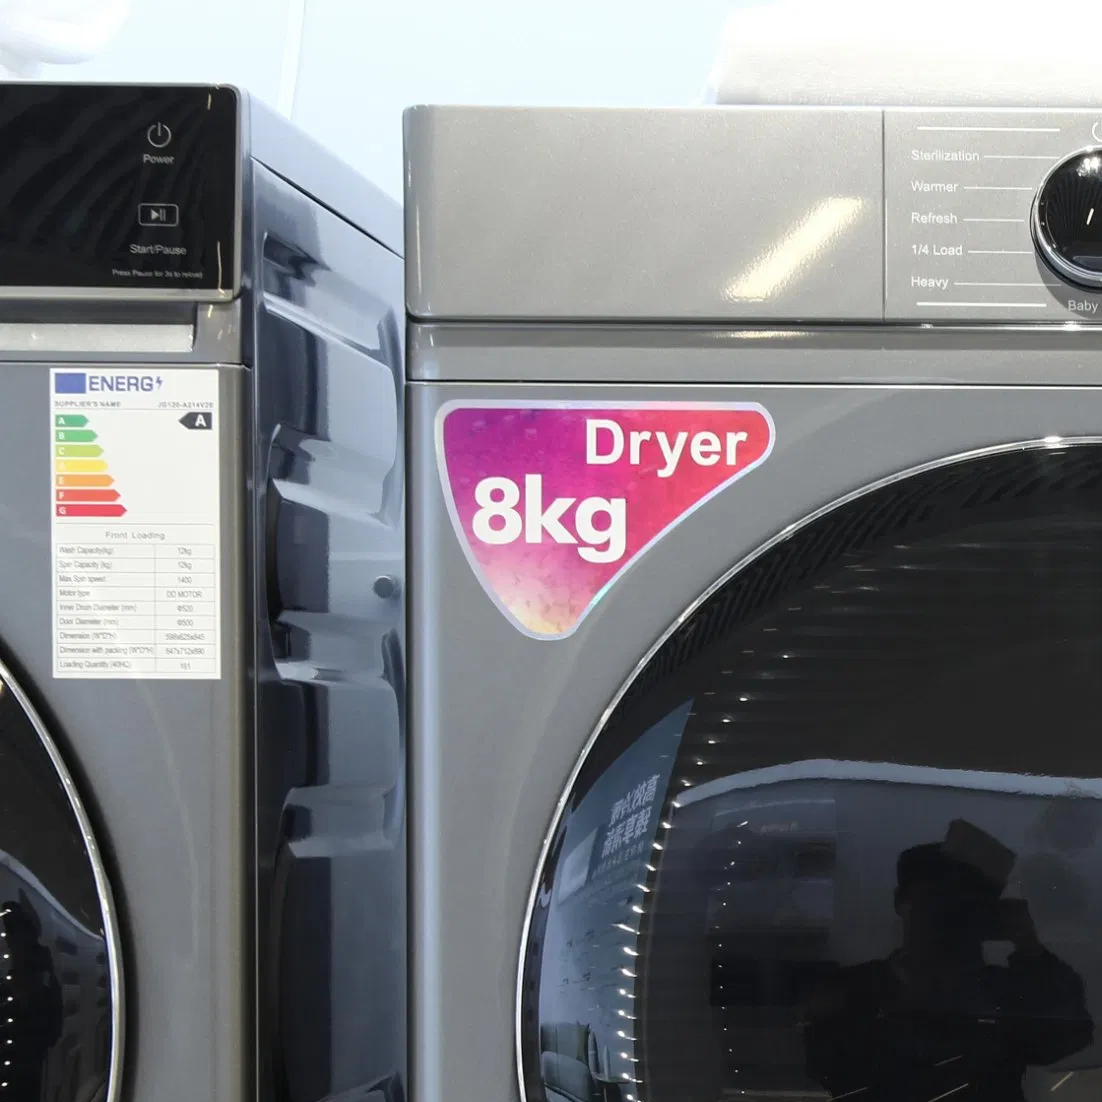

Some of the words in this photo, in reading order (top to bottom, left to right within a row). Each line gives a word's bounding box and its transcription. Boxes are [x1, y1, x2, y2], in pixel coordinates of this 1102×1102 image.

[143, 154, 174, 164] Power
[911, 149, 980, 161] Sterilization
[911, 181, 958, 192] Warmer
[911, 212, 958, 224] Refresh
[130, 244, 187, 255] Start/Pause
[911, 244, 930, 256] 1/4
[933, 244, 962, 256] Load
[911, 276, 949, 290] Heavy
[1068, 300, 1099, 315] Baby
[89, 376, 153, 392] ENERG
[59, 417, 65, 425] A
[195, 414, 207, 427] A
[586, 419, 748, 478] Dryer
[472, 474, 627, 563] 8kg
[131, 532, 166, 541] Loading
